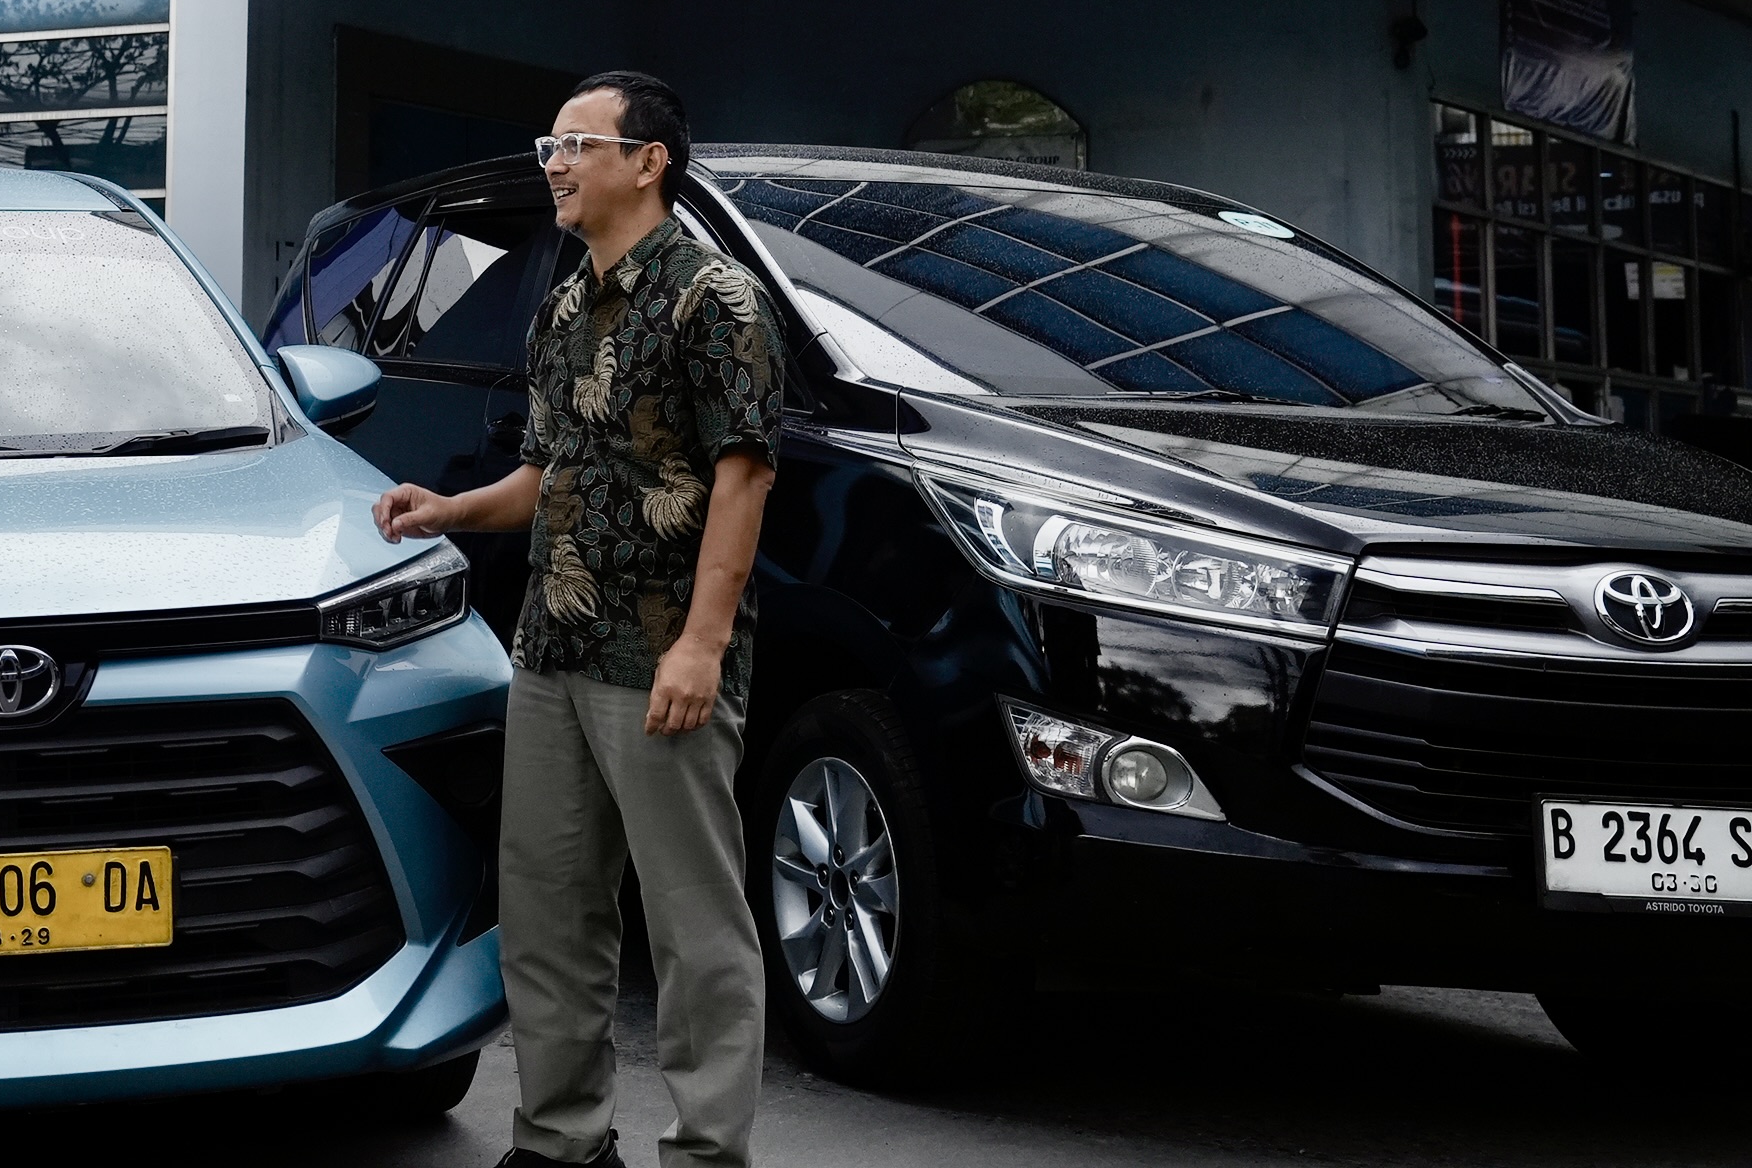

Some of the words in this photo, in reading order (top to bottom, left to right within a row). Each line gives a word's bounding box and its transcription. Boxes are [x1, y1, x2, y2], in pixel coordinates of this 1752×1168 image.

[1551, 808, 1576, 859] B
[1602, 810, 1706, 866] 2364
[1645, 902, 1686, 913] ASTRIDO
[1688, 903, 1724, 914] TOYOTA
